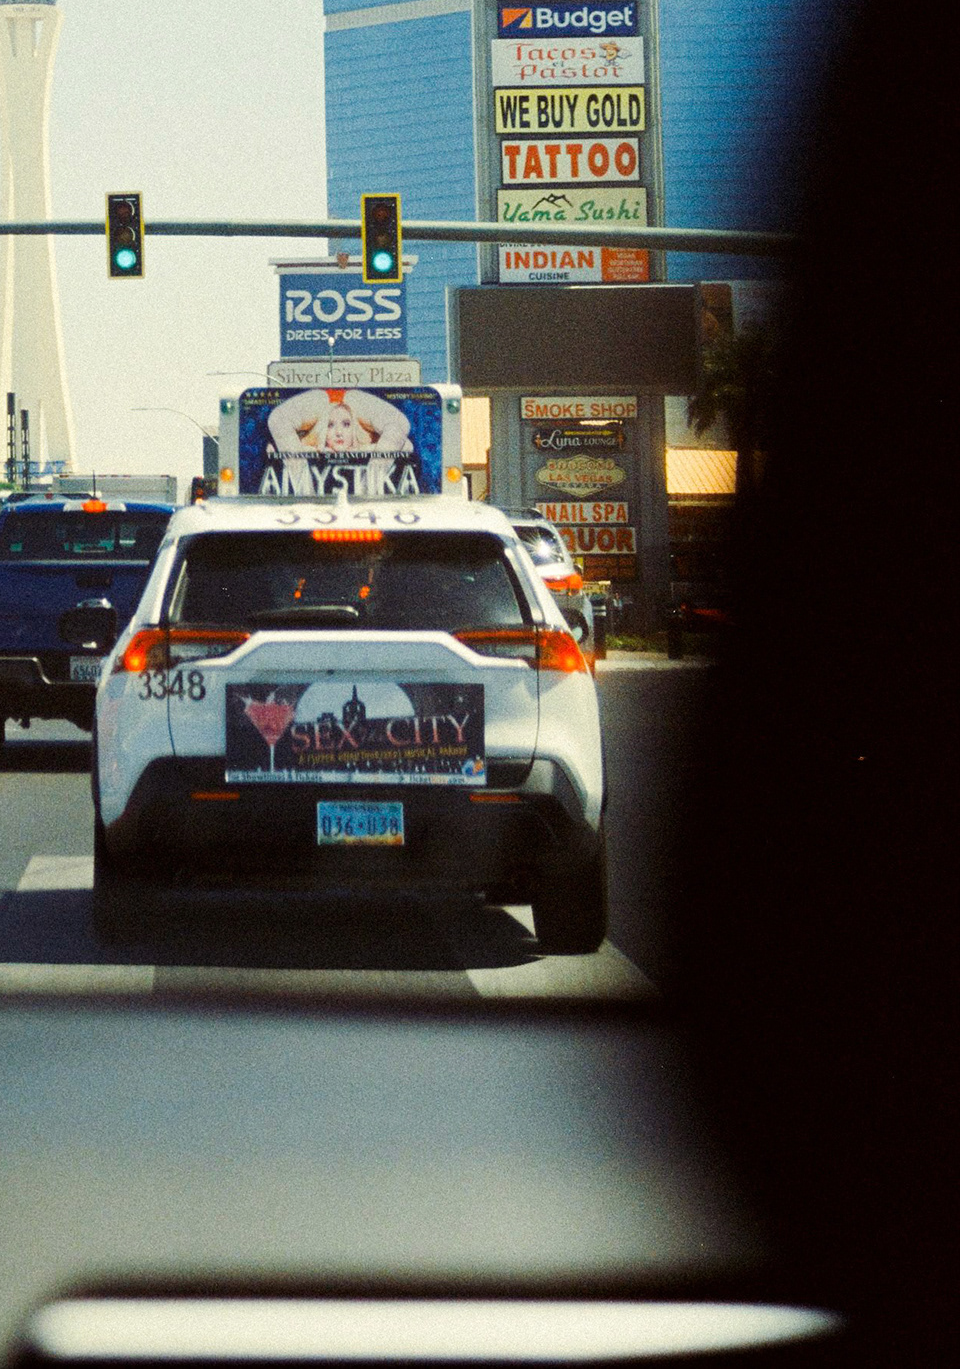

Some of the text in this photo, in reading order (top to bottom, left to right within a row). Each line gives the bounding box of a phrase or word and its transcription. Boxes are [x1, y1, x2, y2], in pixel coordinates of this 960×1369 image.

[536, 6, 633, 33] Budget
[507, 42, 596, 61] Tacos
[512, 63, 624, 80] Pastor
[499, 93, 641, 129] WE BUY GOLD
[504, 141, 637, 179] TATTOO
[502, 199, 641, 223] Yama Sushi
[505, 251, 595, 270] INDIAN
[528, 272, 571, 281] CUISINE
[285, 288, 402, 322] ROSS
[286, 328, 402, 341] DRESS FOR LESS
[276, 367, 412, 387] Silver City Plaza
[524, 403, 636, 418] SMOKE SHOP
[540, 430, 616, 450] Luna LOUNGE
[258, 465, 420, 496] AMYSTIKA
[548, 473, 613, 483] LAS VEGAS
[546, 502, 627, 522] NAIL SPA
[560, 527, 634, 552] QUOR
[139, 669, 206, 701] 3348
[290, 718, 360, 753] SEX
[386, 713, 470, 747] CITY
